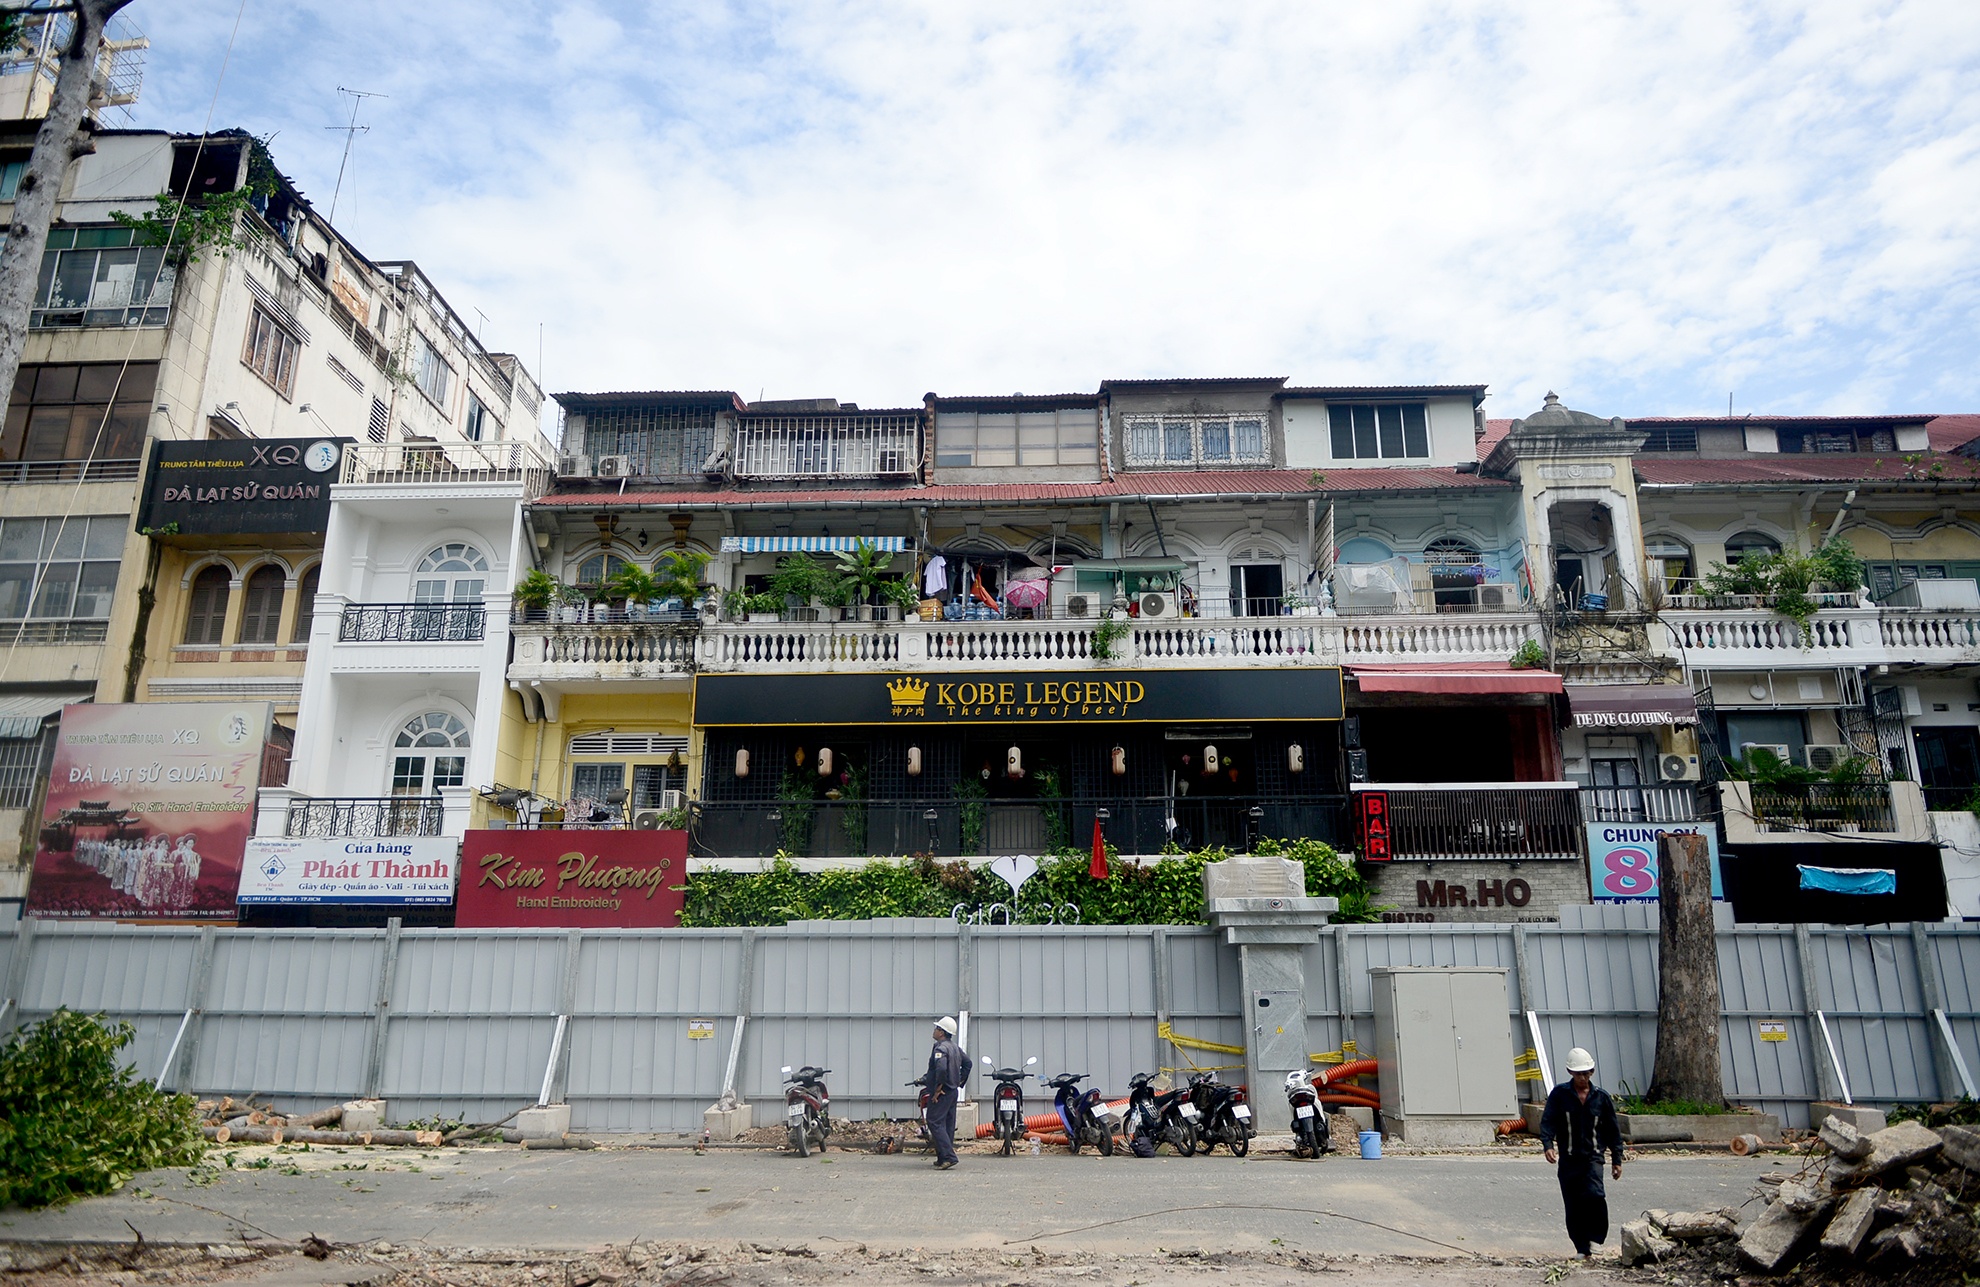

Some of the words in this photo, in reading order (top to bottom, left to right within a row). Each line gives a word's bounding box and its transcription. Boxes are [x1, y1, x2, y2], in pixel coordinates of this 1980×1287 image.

[160, 461, 188, 469] TRUNG
[189, 460, 206, 468] TÂM
[229, 460, 244, 469] LỤA
[251, 445, 300, 466] XQ
[164, 484, 192, 501] ĐÀ
[197, 487, 230, 503] LẠT
[232, 481, 260, 500] SỬ
[263, 482, 320, 500] QUÁN
[936, 682, 1016, 705] KOBE
[1025, 681, 1145, 704] LEGEND
[946, 705, 981, 716] The
[993, 705, 1039, 717] king
[1050, 705, 1070, 718] of
[1081, 703, 1130, 716] beef
[1573, 712, 1593, 726] TIE
[1593, 712, 1616, 725] DYE
[1618, 711, 1673, 725] CLOTHING
[65, 734, 96, 744] TRUNG
[99, 733, 118, 744] TÂM
[171, 729, 200, 745] XQ
[69, 764, 94, 782] ĐÀ
[101, 767, 134, 786] LẠT
[137, 761, 163, 783] SỬ
[167, 762, 226, 782] QUÁN
[130, 802, 145, 812] XQ
[148, 802, 164, 812] Silk
[167, 801, 192, 812] Hand
[194, 801, 249, 813] Embroidery
[1367, 799, 1386, 854] BAR
[345, 841, 372, 854] Cửa
[376, 842, 413, 855] hàng
[301, 859, 361, 879] Phát
[367, 859, 449, 879] Thành
[478, 853, 546, 890] Kim
[557, 851, 664, 899] Phượng
[299, 883, 318, 891] Giày
[386, 883, 403, 891] Vali
[412, 883, 426, 891] Túi
[428, 883, 449, 891] xách
[516, 896, 549, 908] Hand
[550, 896, 622, 911] Embroidery
[1382, 913, 1435, 923] BISTRO
